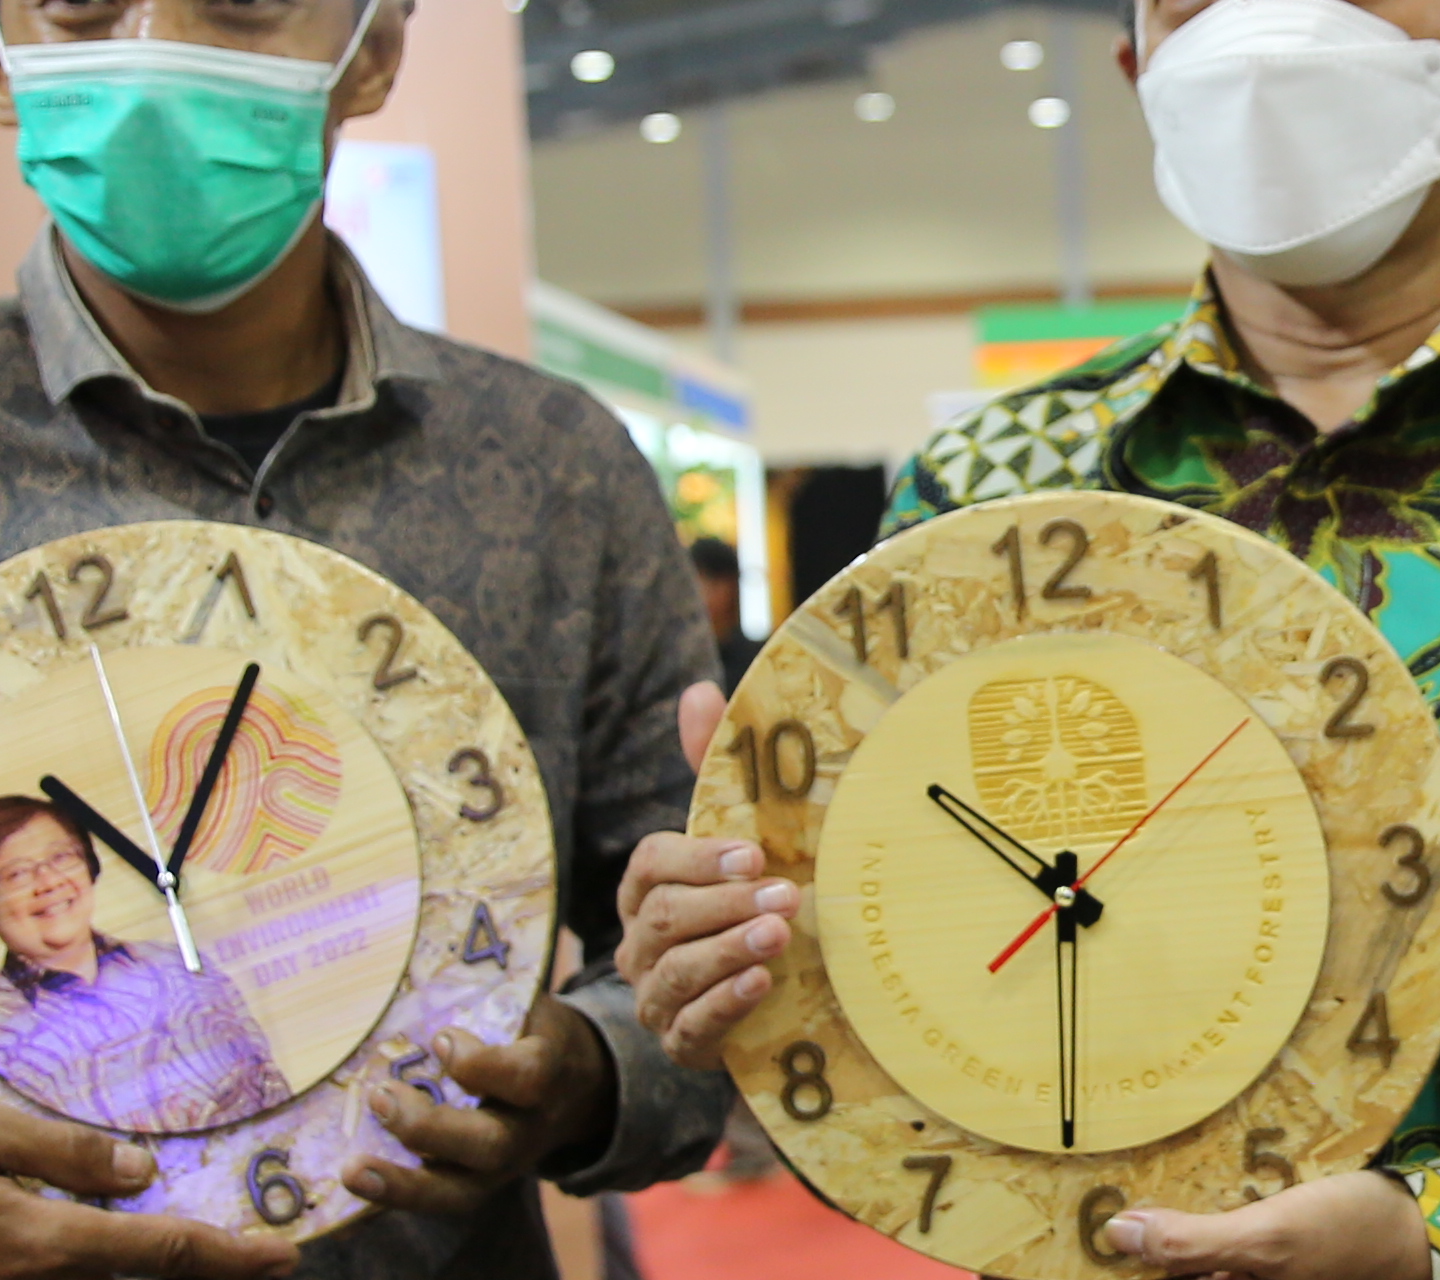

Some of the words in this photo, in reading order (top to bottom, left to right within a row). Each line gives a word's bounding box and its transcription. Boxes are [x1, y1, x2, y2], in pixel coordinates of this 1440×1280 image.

[25, 554, 127, 640] 12
[217, 551, 257, 620] 1
[991, 519, 1091, 621] 12
[1190, 550, 1224, 632] 1
[360, 613, 417, 693] 2
[833, 580, 910, 664] 11
[1319, 656, 1376, 739] 2
[448, 747, 506, 823] 3
[727, 722, 817, 804] 10
[244, 866, 331, 916] WORLD
[1244, 806, 1285, 986] FORESTRY
[1379, 824, 1432, 907] 3
[254, 951, 300, 989] DAY
[306, 927, 371, 968] 2022
[460, 900, 512, 971] 4
[1346, 990, 1400, 1070] 4
[778, 1040, 833, 1121] 8
[245, 1148, 307, 1228] 6
[901, 1154, 953, 1234] 7
[1244, 1128, 1296, 1202] 5
[1077, 1184, 1131, 1268] 6
